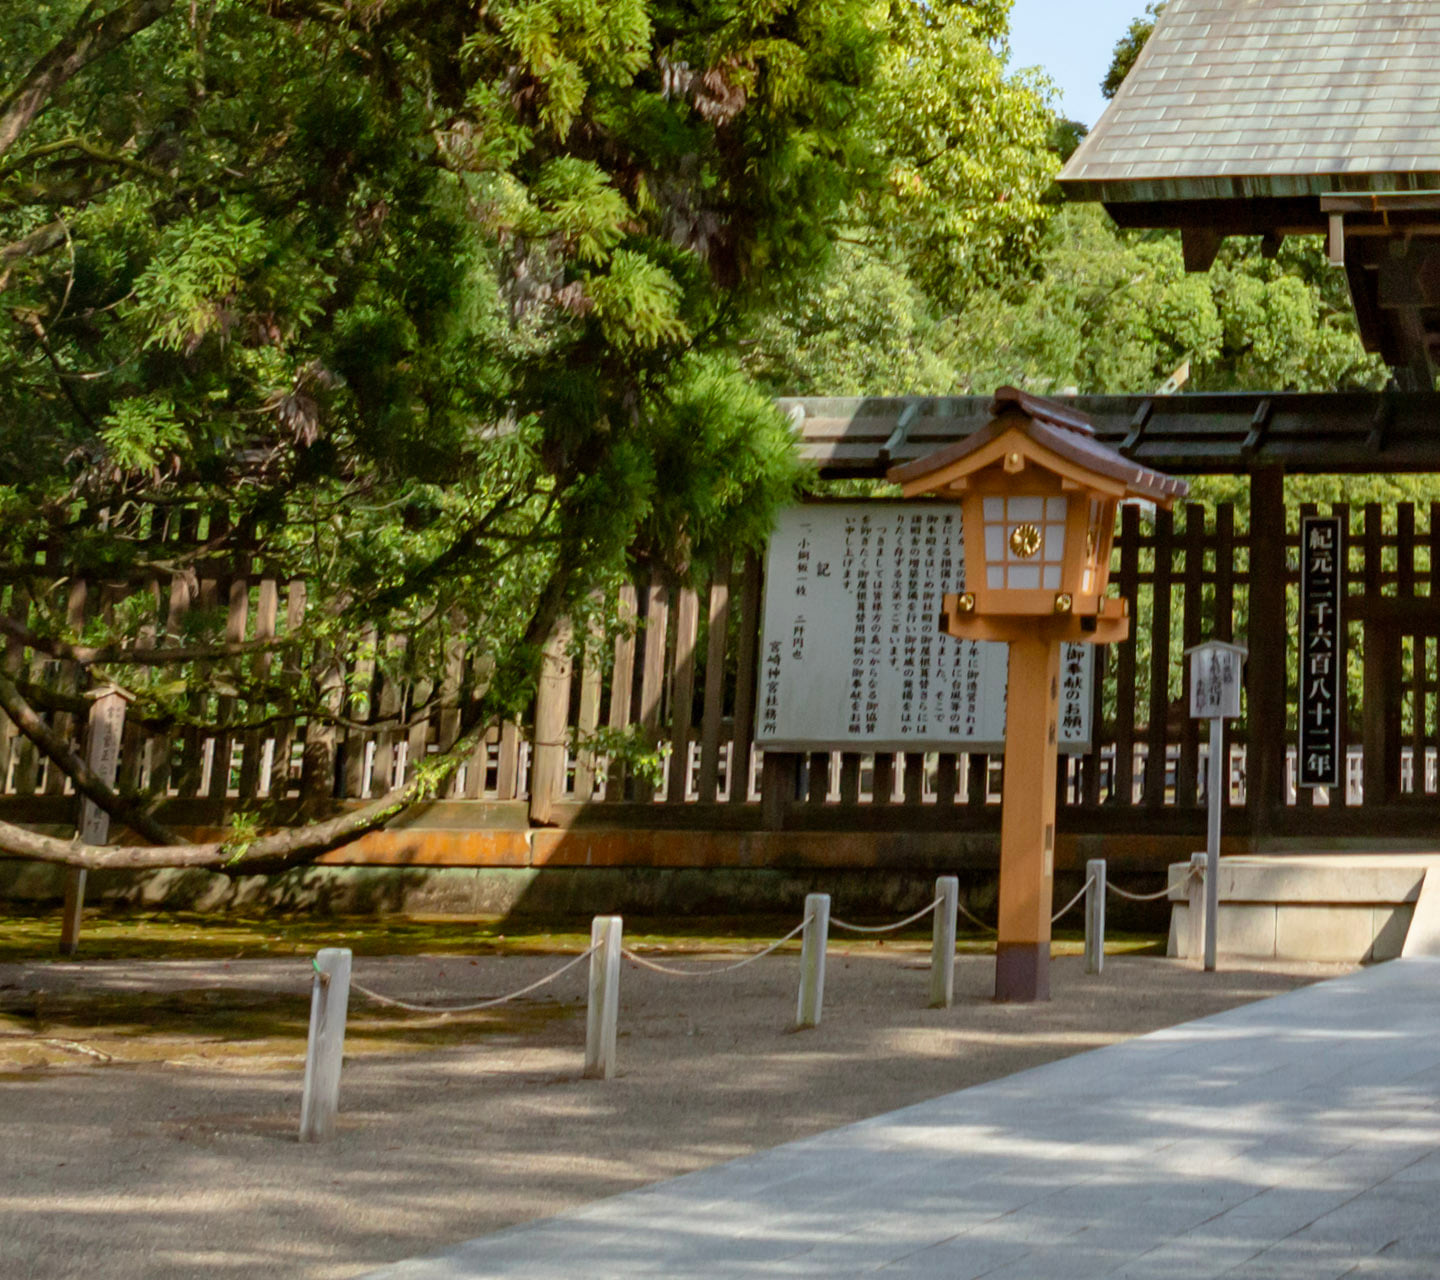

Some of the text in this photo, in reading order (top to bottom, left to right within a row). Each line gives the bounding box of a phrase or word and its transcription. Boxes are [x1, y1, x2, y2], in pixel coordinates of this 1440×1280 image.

[816, 561, 831, 578] 記
[762, 640, 782, 734] 宮崎神宮社務所
[1307, 526, 1334, 777] 紀元二千六百八十二年
